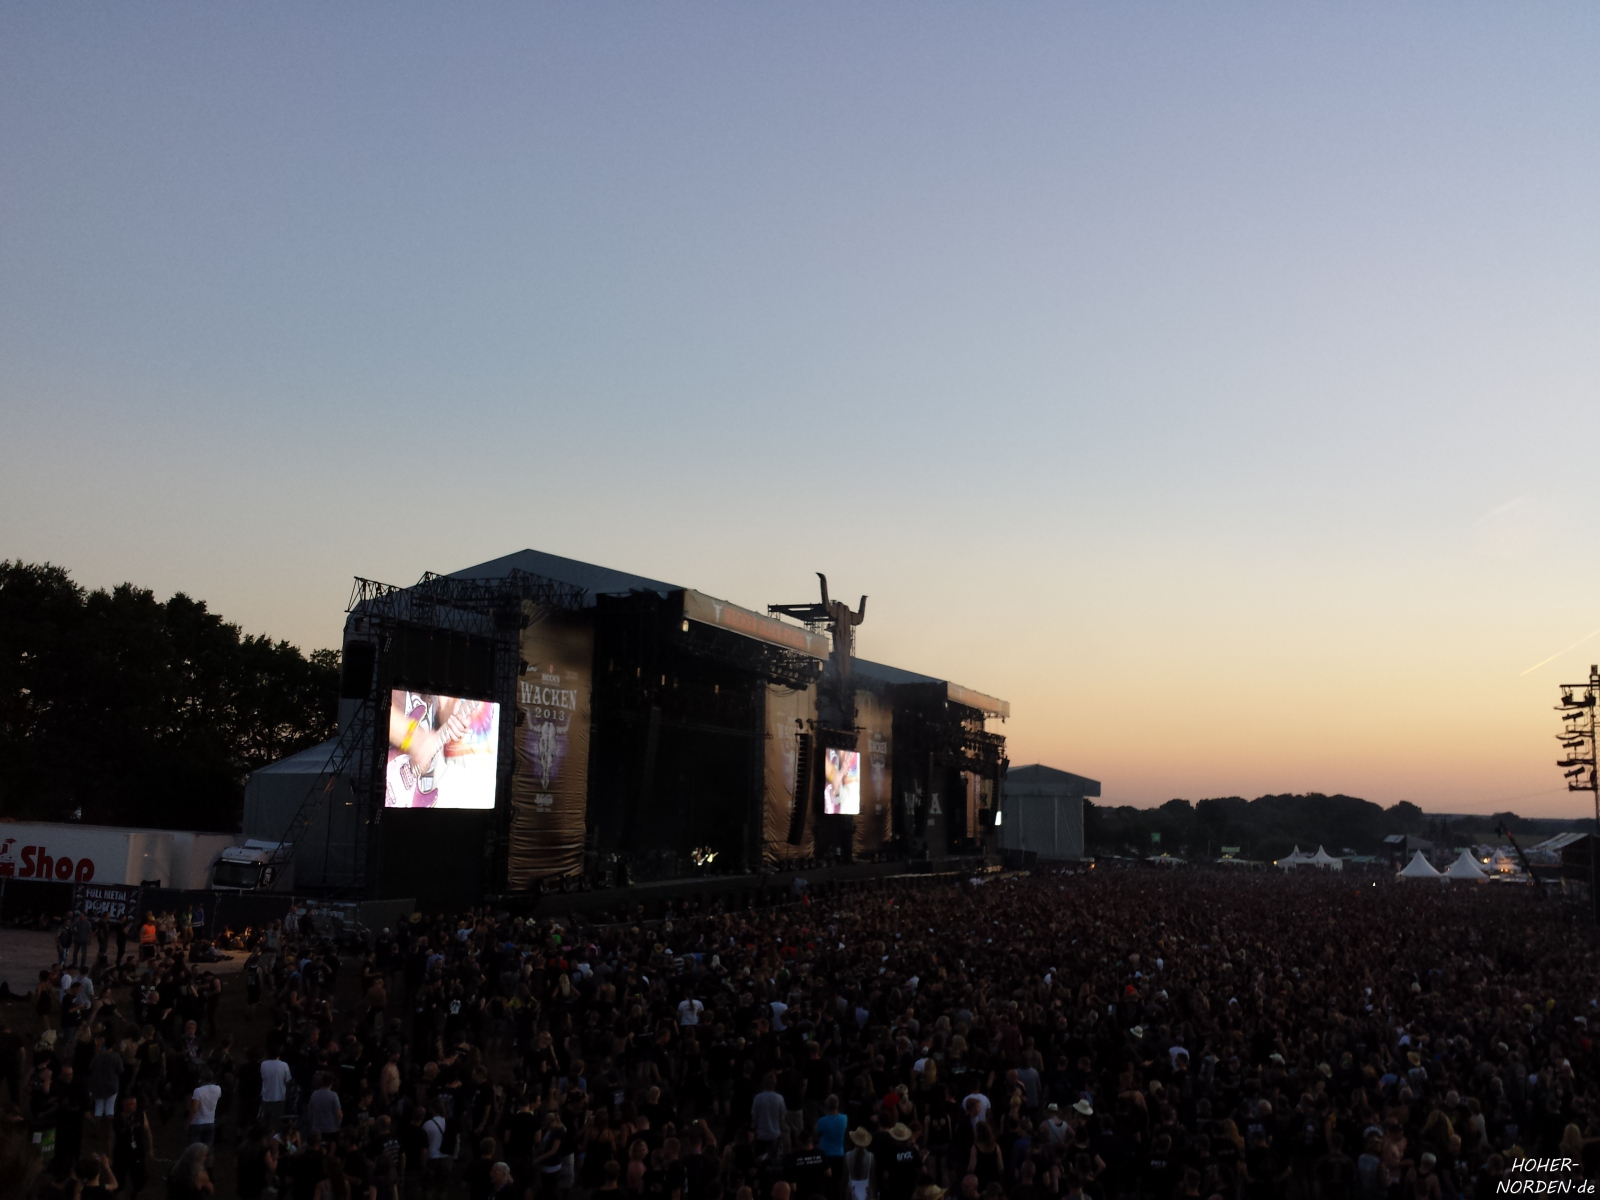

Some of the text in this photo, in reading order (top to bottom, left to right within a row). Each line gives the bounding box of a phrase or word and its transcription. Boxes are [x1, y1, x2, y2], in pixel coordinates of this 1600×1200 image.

[520, 680, 577, 711] WACKEN
[535, 707, 565, 721] 2013
[18, 846, 95, 882] Shop
